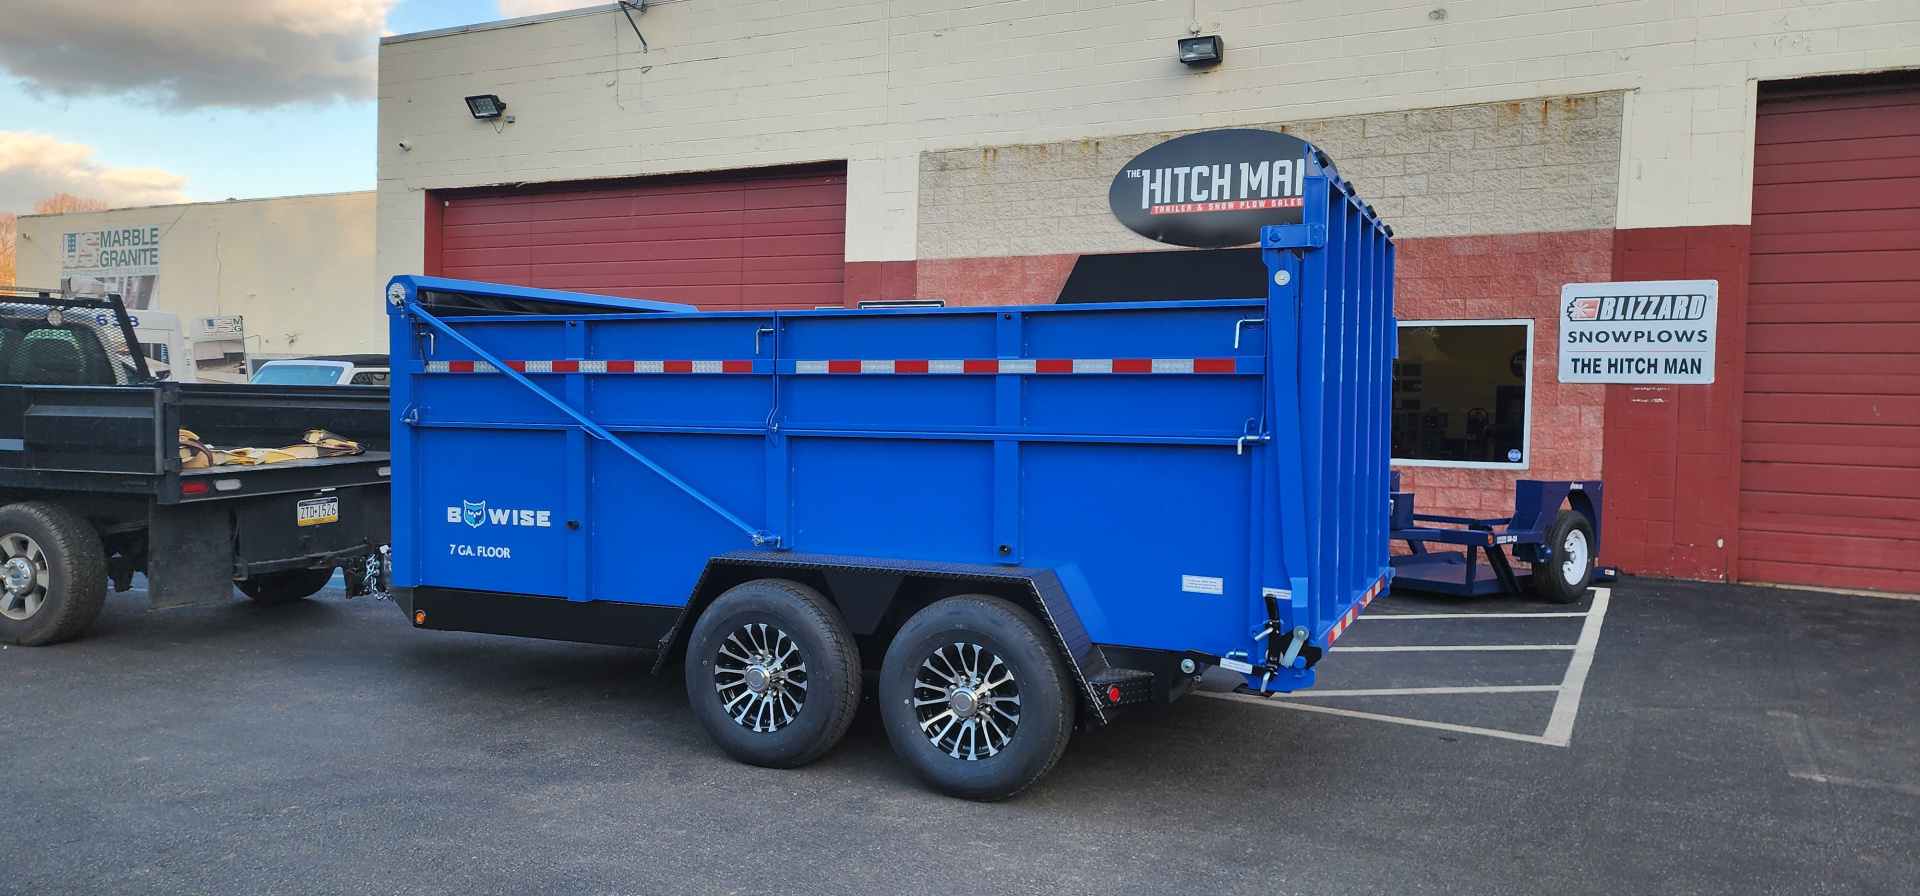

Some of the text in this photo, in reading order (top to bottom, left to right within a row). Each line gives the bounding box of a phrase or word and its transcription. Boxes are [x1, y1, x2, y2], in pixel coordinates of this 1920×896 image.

[1126, 169, 1141, 179] THE
[1141, 163, 1232, 210] HITCH
[1154, 198, 1302, 214] TRAILER & SNOW PLOW SALES
[100, 227, 159, 248] MARBLE
[63, 231, 99, 269] US
[100, 247, 159, 268] GRANITE
[1600, 295, 1706, 320] BLIZZARD
[1567, 330, 1708, 344] SNOWPLOWS
[1571, 358, 1702, 374] THE HITCH MAN
[449, 544, 511, 559] 7 GA. FLOOR
